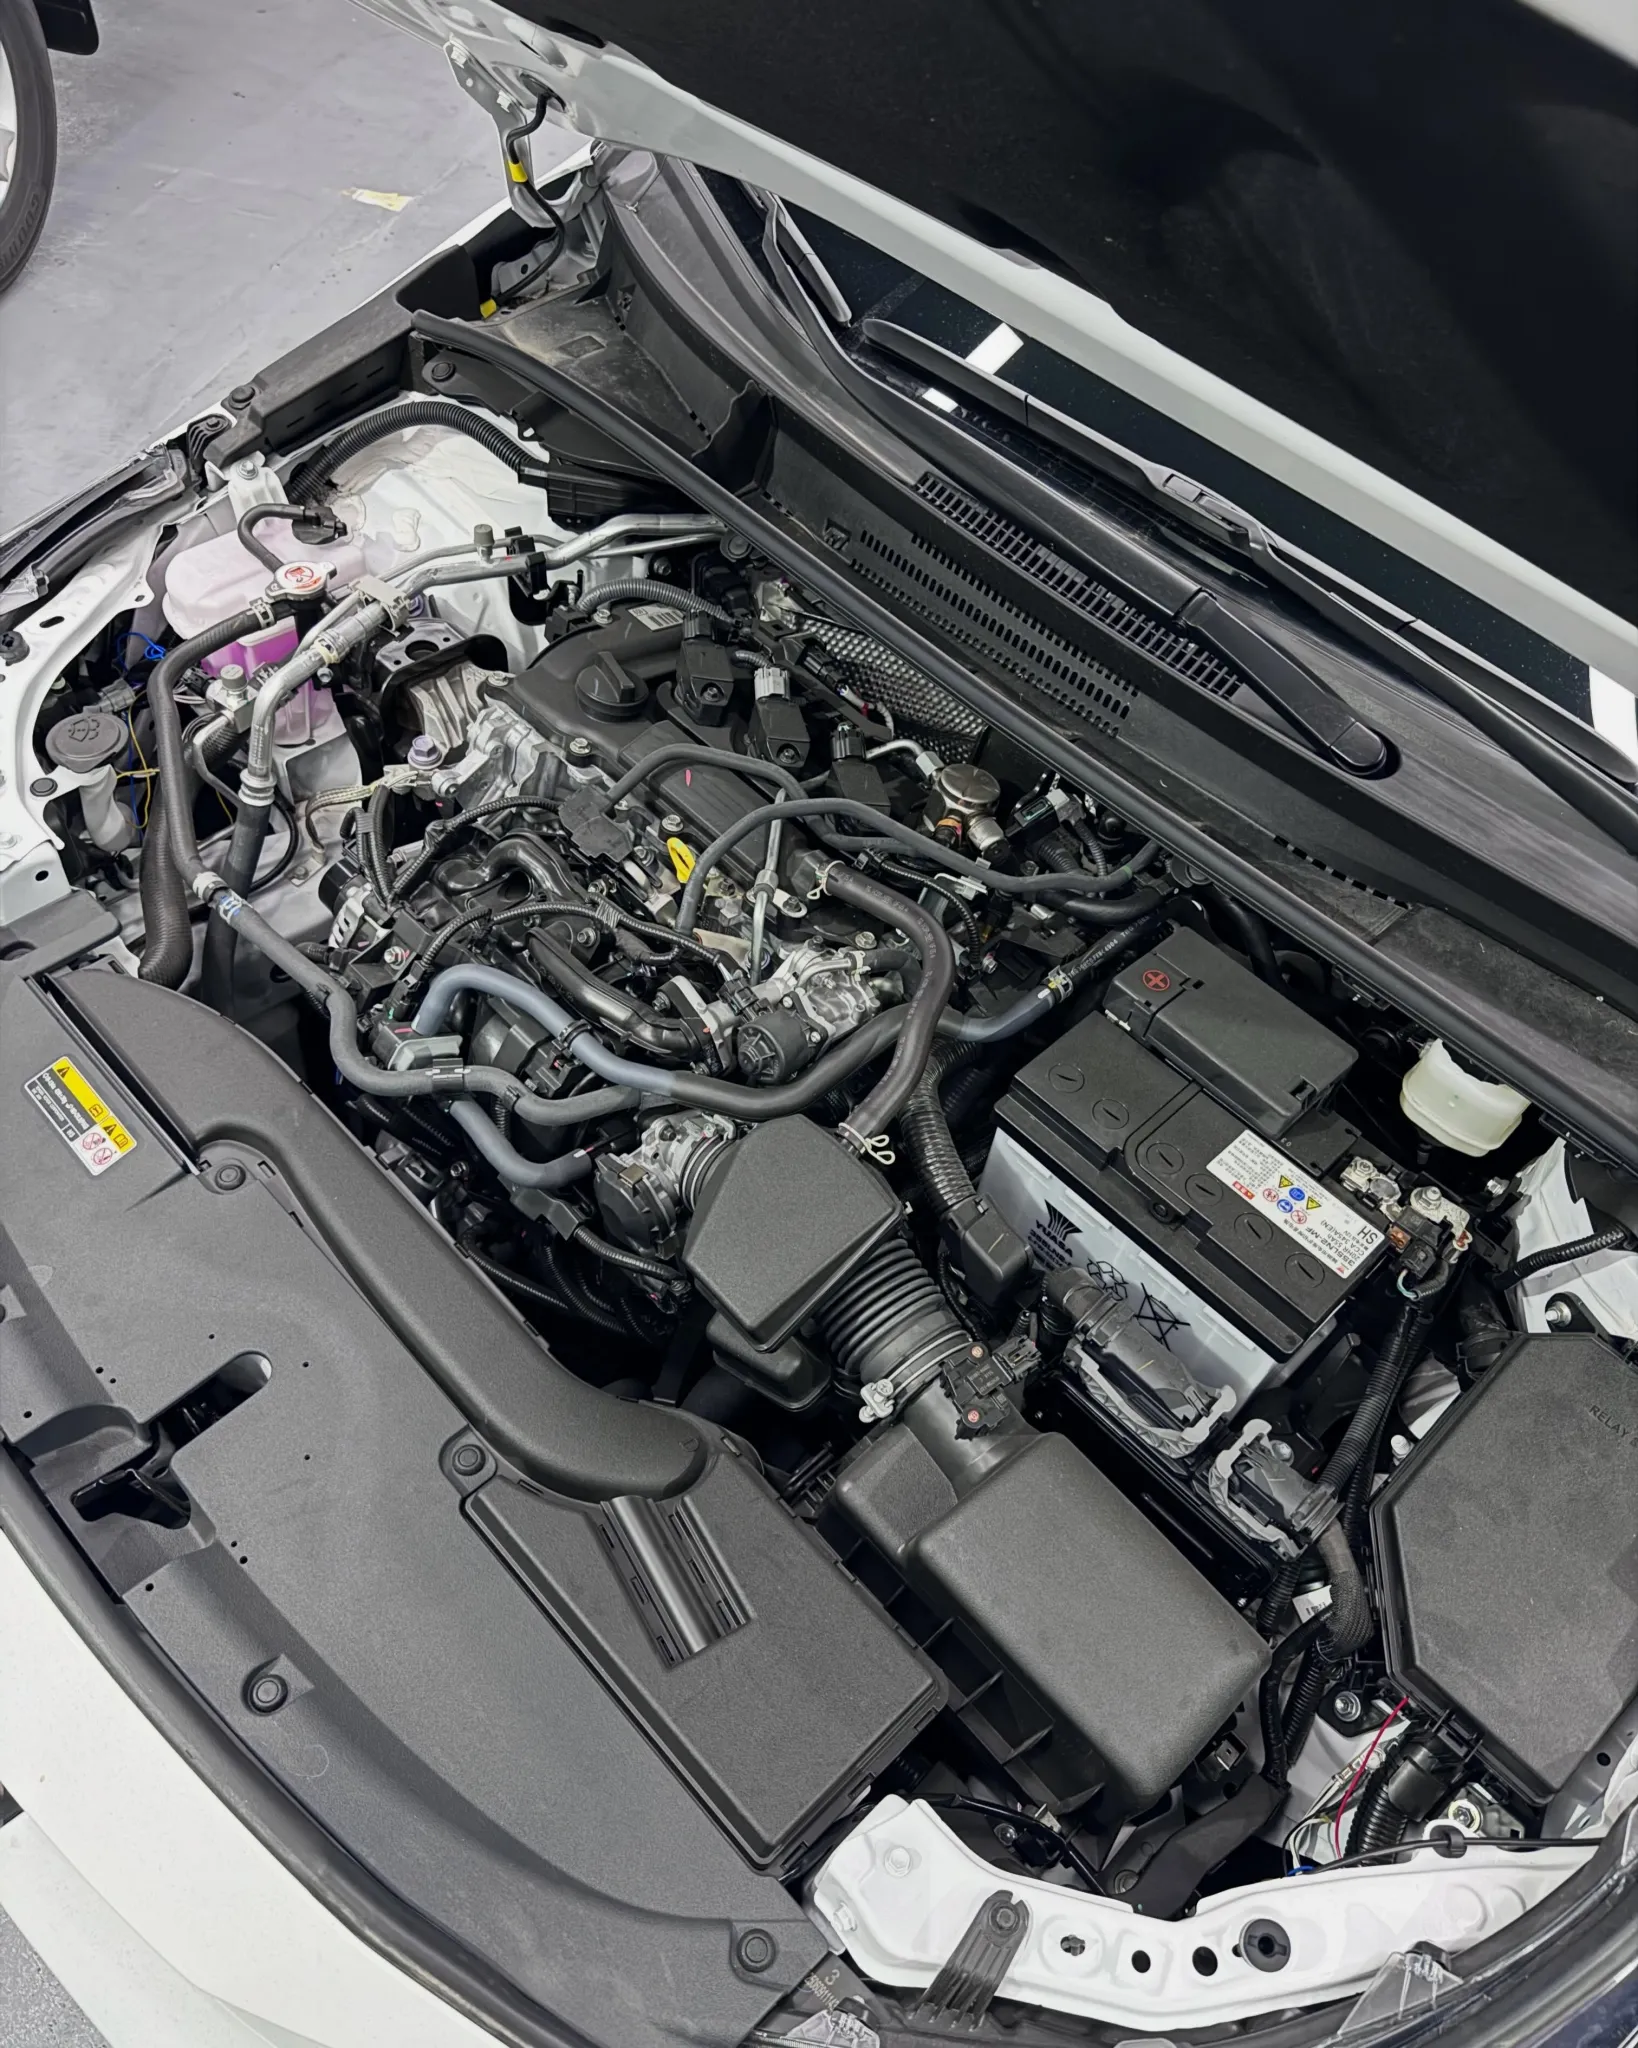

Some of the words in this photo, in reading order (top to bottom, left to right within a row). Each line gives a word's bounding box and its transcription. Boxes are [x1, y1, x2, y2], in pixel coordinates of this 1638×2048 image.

[1035, 1219, 1074, 1258] YUASA
[1319, 1218, 1351, 1245] 345A(EN)
[1325, 1232, 1343, 1248] 55Ah
[1356, 1224, 1378, 1246] SH
[1304, 1224, 1355, 1267] 355LN2-MF
[1341, 1245, 1360, 1262] 20HR
[1348, 1241, 1365, 1257] CCA
[1589, 1404, 1630, 1438] RELAY
[824, 1968, 841, 1986] 3
